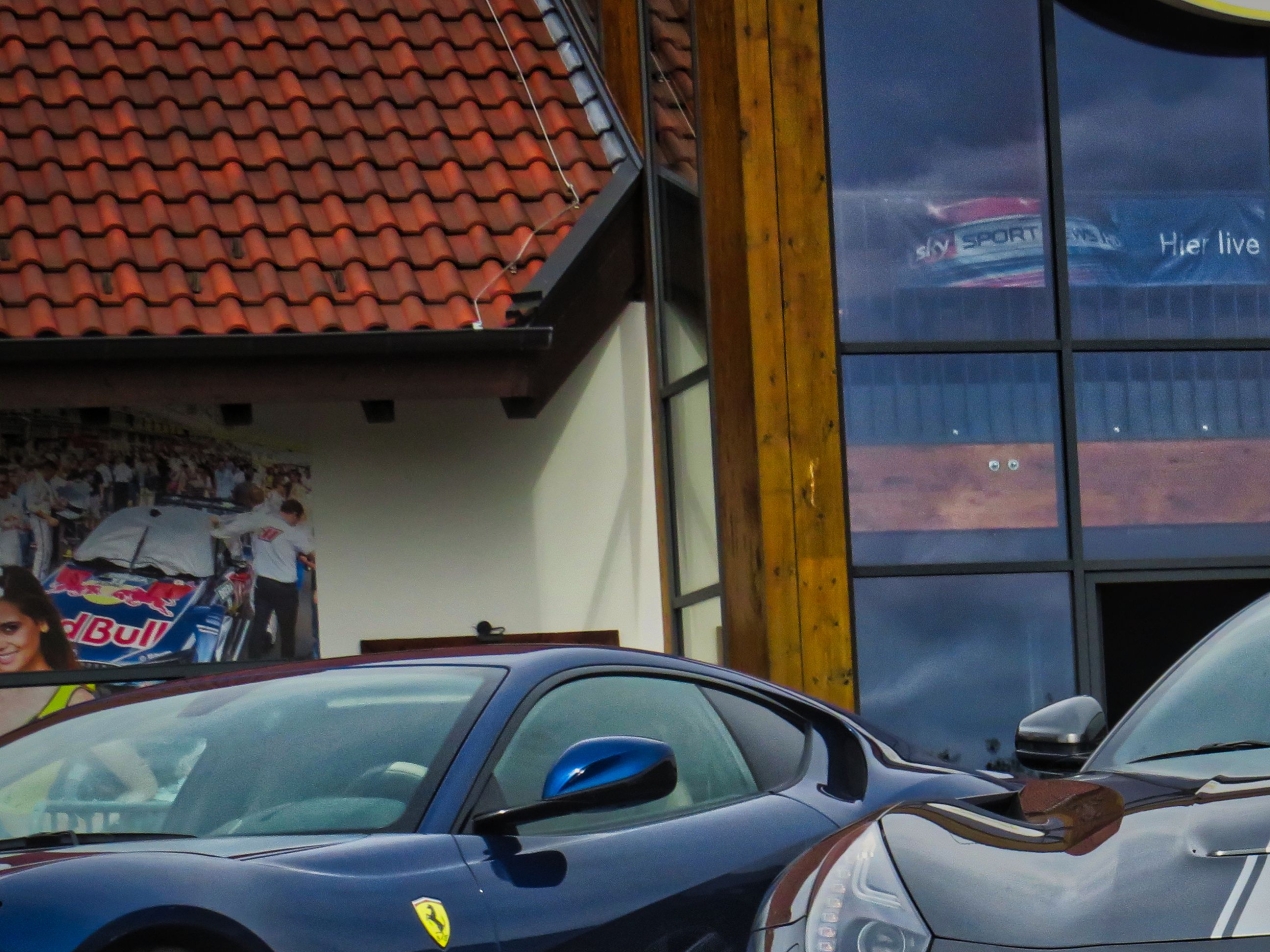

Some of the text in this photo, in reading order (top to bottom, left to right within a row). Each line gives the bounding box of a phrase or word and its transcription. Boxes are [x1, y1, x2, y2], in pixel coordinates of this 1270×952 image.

[916, 236, 949, 261] sky
[962, 225, 1039, 249] SPORT
[1160, 231, 1209, 256] Hier
[1218, 230, 1260, 255] live
